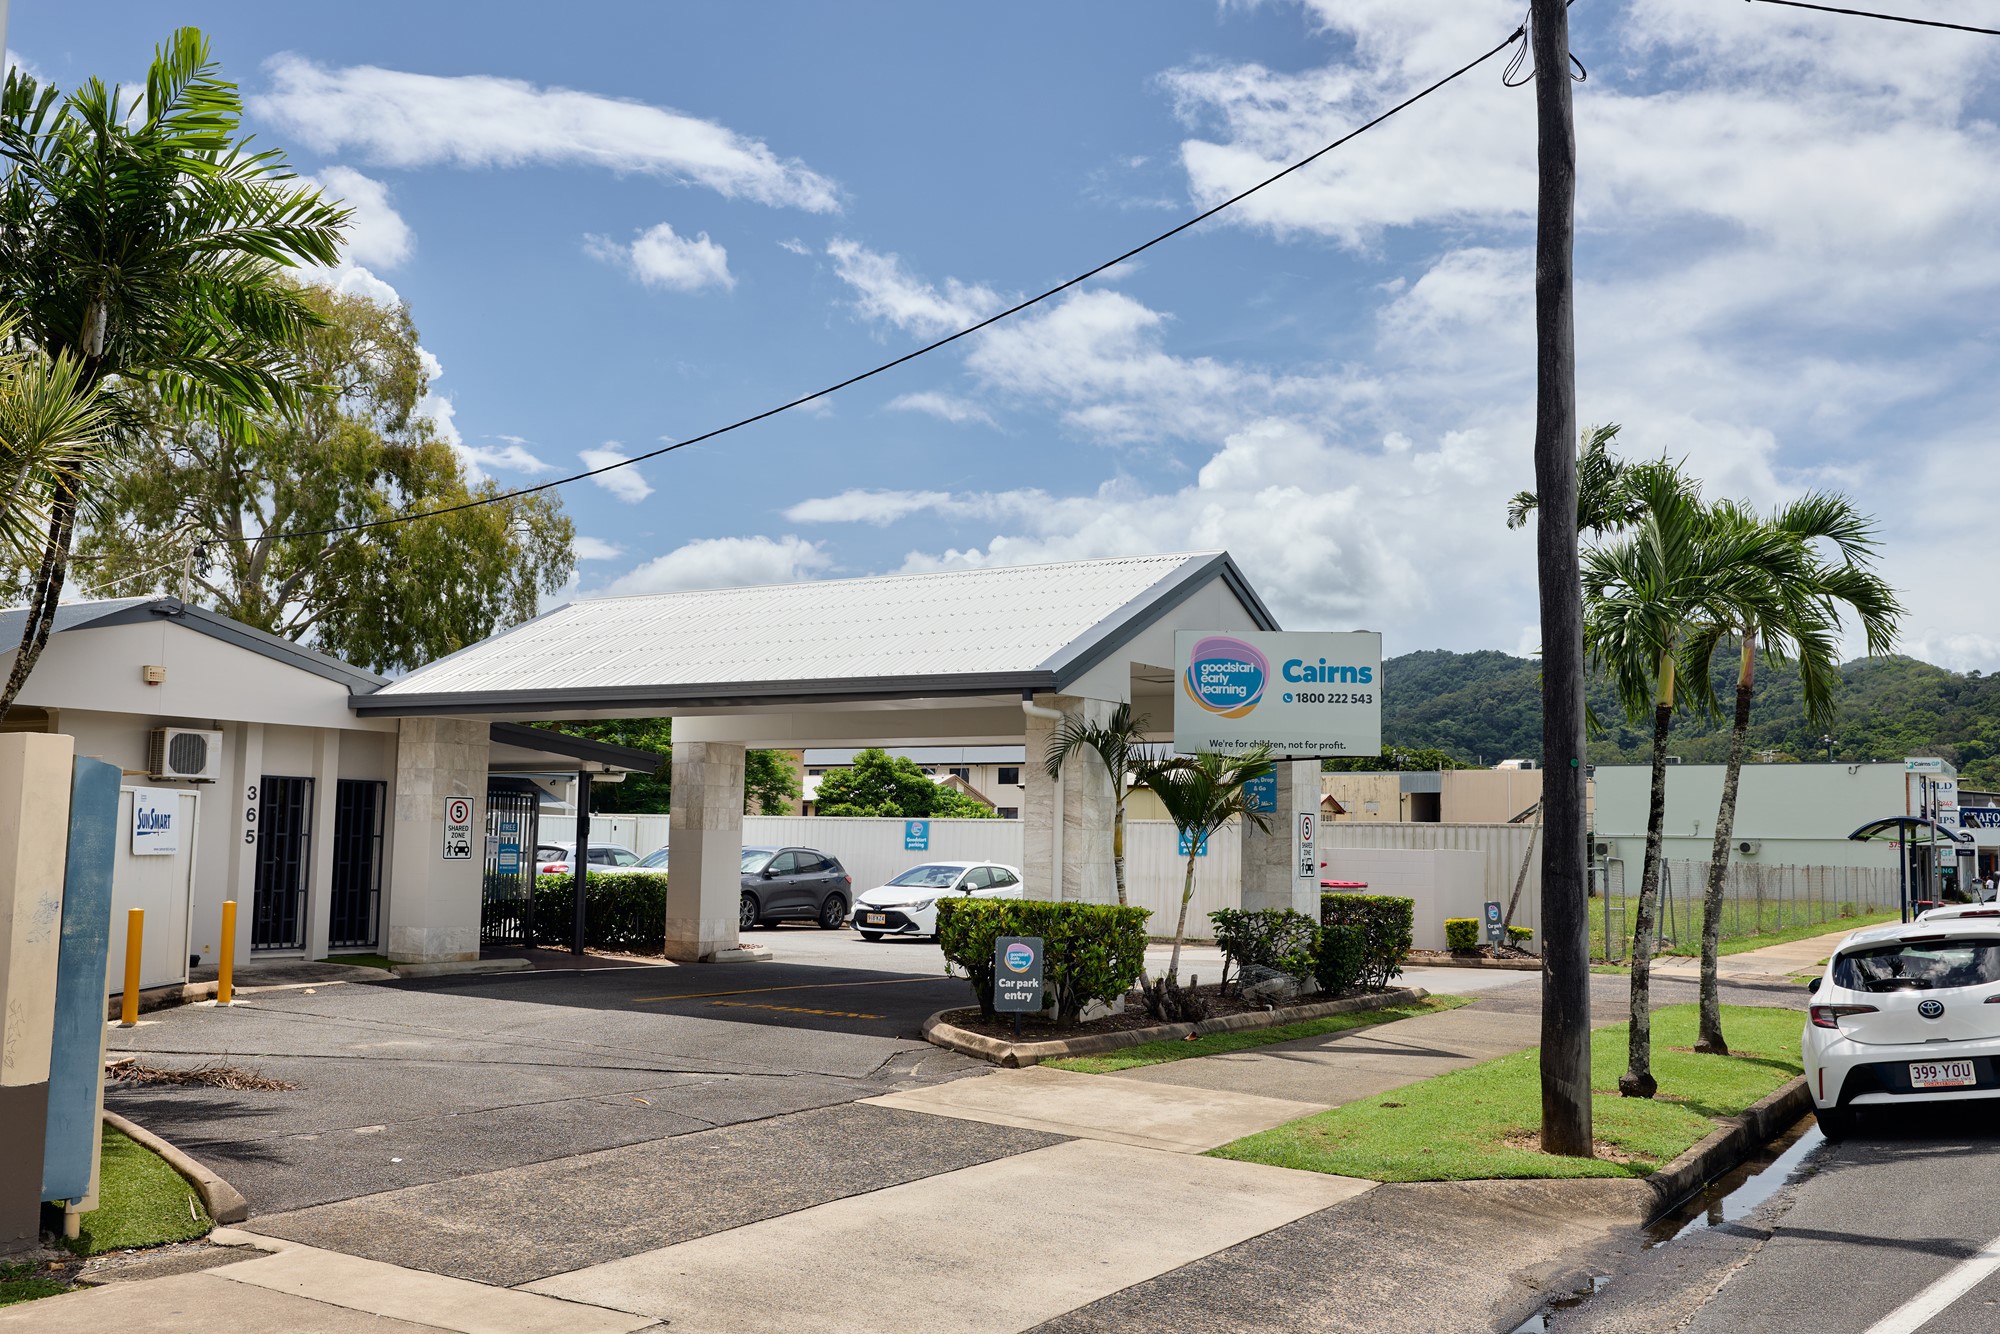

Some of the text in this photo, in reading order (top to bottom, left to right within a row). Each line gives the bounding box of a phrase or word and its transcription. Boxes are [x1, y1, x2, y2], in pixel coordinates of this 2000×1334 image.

[1200, 662, 1255, 674] goodstart
[1282, 657, 1373, 684] Cairns
[1200, 673, 1229, 685] early
[1201, 683, 1247, 697] learning
[1295, 692, 1373, 704] 1800 222 543
[1209, 739, 1347, 751] We're for children, not for profit.
[456, 806, 462, 818] 5
[1305, 822, 1309, 835] 5
[998, 977, 1039, 989] Car park
[1004, 991, 1033, 1003] entry
